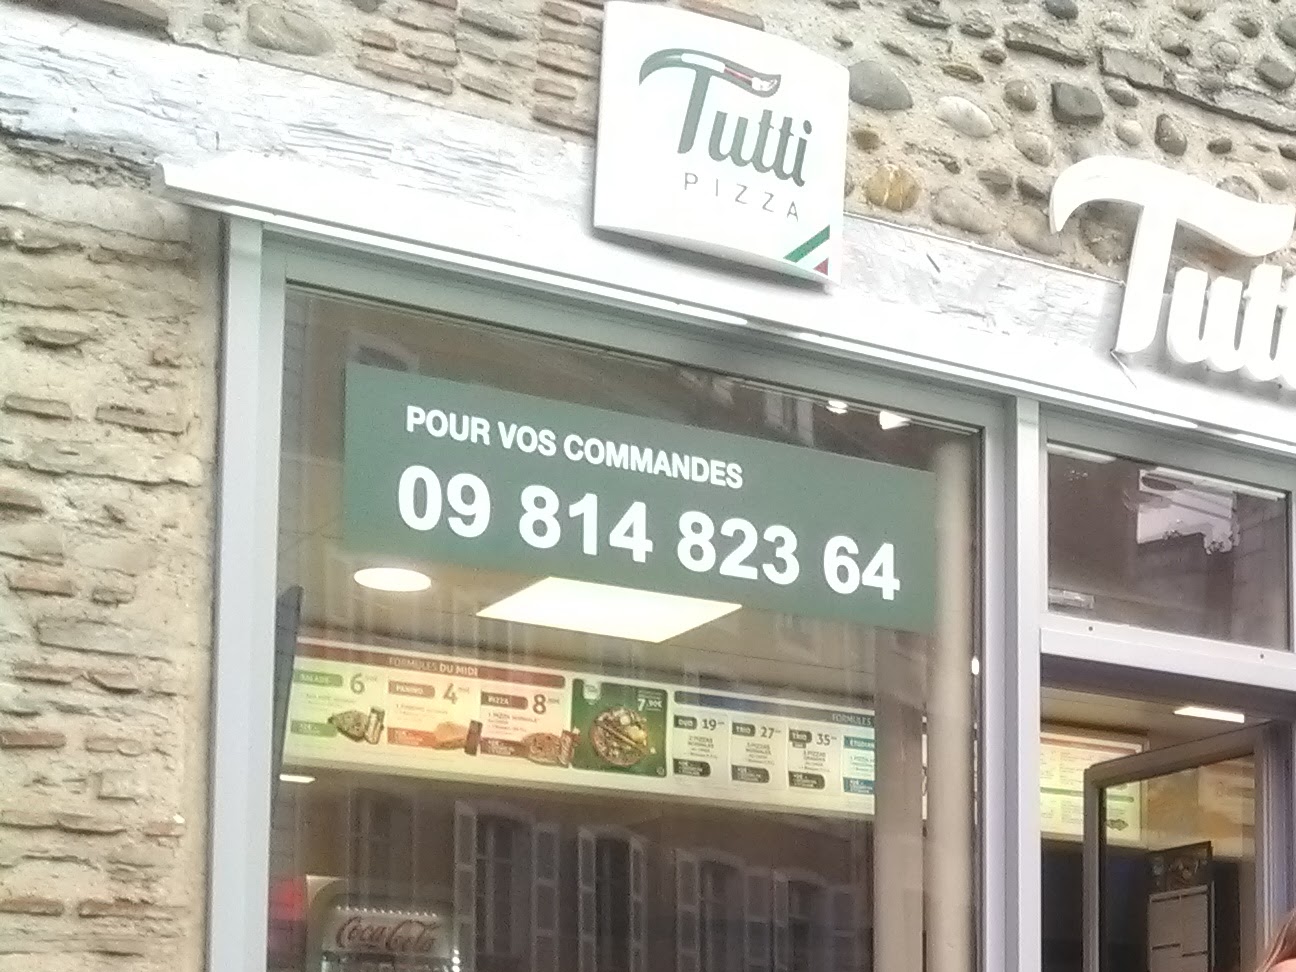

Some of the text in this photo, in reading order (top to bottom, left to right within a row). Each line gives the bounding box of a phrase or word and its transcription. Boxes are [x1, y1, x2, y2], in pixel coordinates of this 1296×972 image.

[639, 48, 812, 187] Tutti
[684, 172, 799, 222] PIZZA
[406, 404, 743, 489] POUR VOS COMMANDES
[398, 465, 901, 601] 09 814 823 64
[440, 663, 454, 673] DU
[456, 665, 478, 677] MIDI
[350, 673, 366, 695] 6
[443, 683, 458, 705] 4
[487, 695, 509, 705] PIZZA
[532, 693, 547, 715] 8
[678, 718, 694, 727] DUO
[702, 718, 717, 731] 19
[832, 713, 871, 726] FORMULES
[735, 725, 751, 734] TRIO
[760, 726, 775, 739] 27
[816, 733, 831, 746] 35
